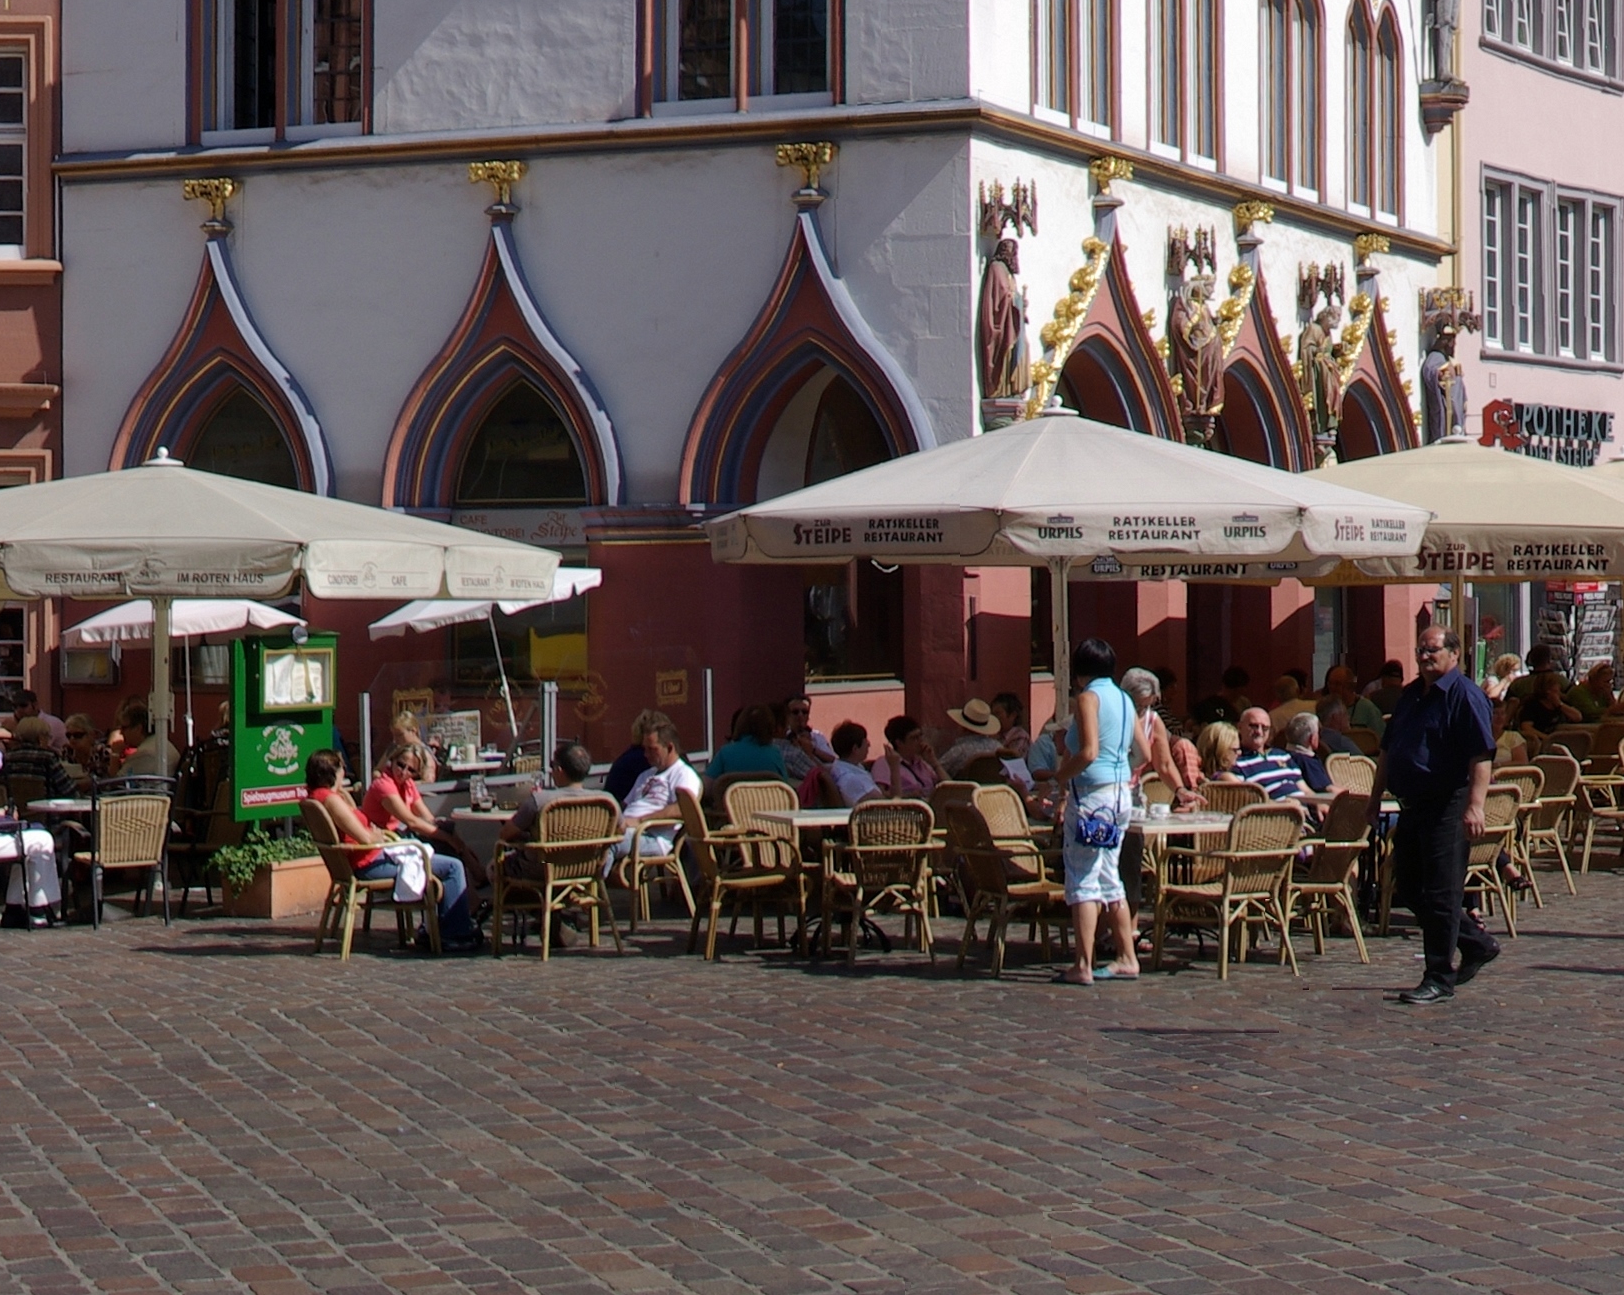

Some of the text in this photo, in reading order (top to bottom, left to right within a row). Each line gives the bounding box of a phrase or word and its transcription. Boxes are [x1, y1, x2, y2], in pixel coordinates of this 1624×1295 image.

[814, 519, 832, 527] ZUR
[868, 518, 940, 530] RATSKELLER
[1113, 516, 1197, 527] RATSKELLER
[793, 523, 852, 546] STEIPE
[864, 531, 944, 543] RESTAURANT
[1037, 526, 1083, 539] URPILS
[1108, 529, 1201, 541] RESTAURANT
[1223, 525, 1267, 538] URPILS
[1446, 543, 1466, 551] ZUR
[1513, 543, 1605, 556] RATSKELLER
[1416, 546, 1494, 570] STEIPE
[1507, 558, 1610, 571] RESTAURANT
[1140, 563, 1249, 577] RESTAURANT
[45, 571, 123, 584] RESTAURANT
[177, 572, 190, 583] IM
[192, 572, 231, 583] ROTEN
[233, 572, 265, 584] HAUS
